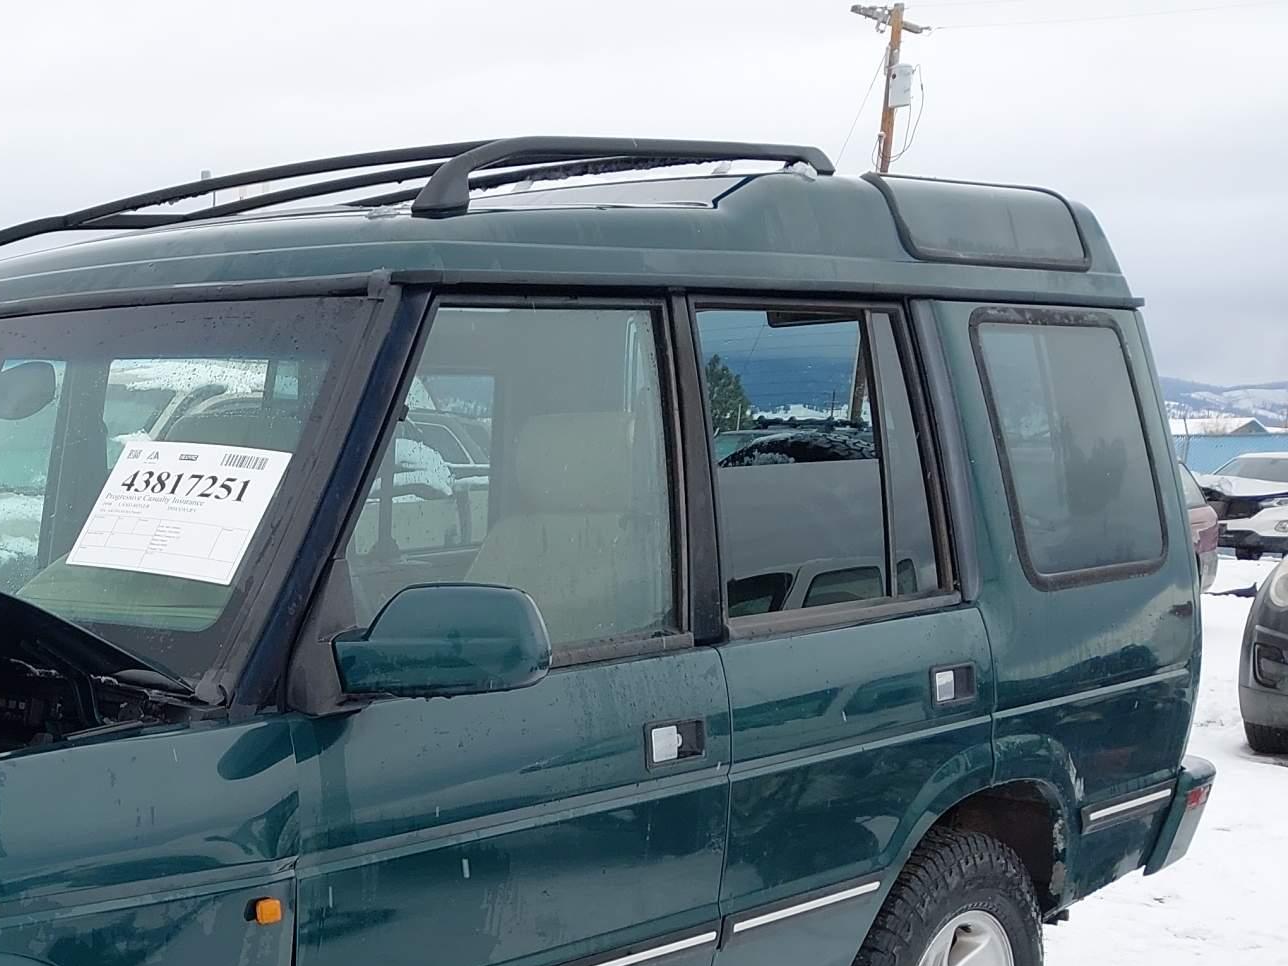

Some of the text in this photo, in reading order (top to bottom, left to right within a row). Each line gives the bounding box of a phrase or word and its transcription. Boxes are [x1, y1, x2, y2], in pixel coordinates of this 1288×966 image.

[121, 470, 251, 502] 43817251
[105, 492, 205, 507] Progressive Casualty Insurance
